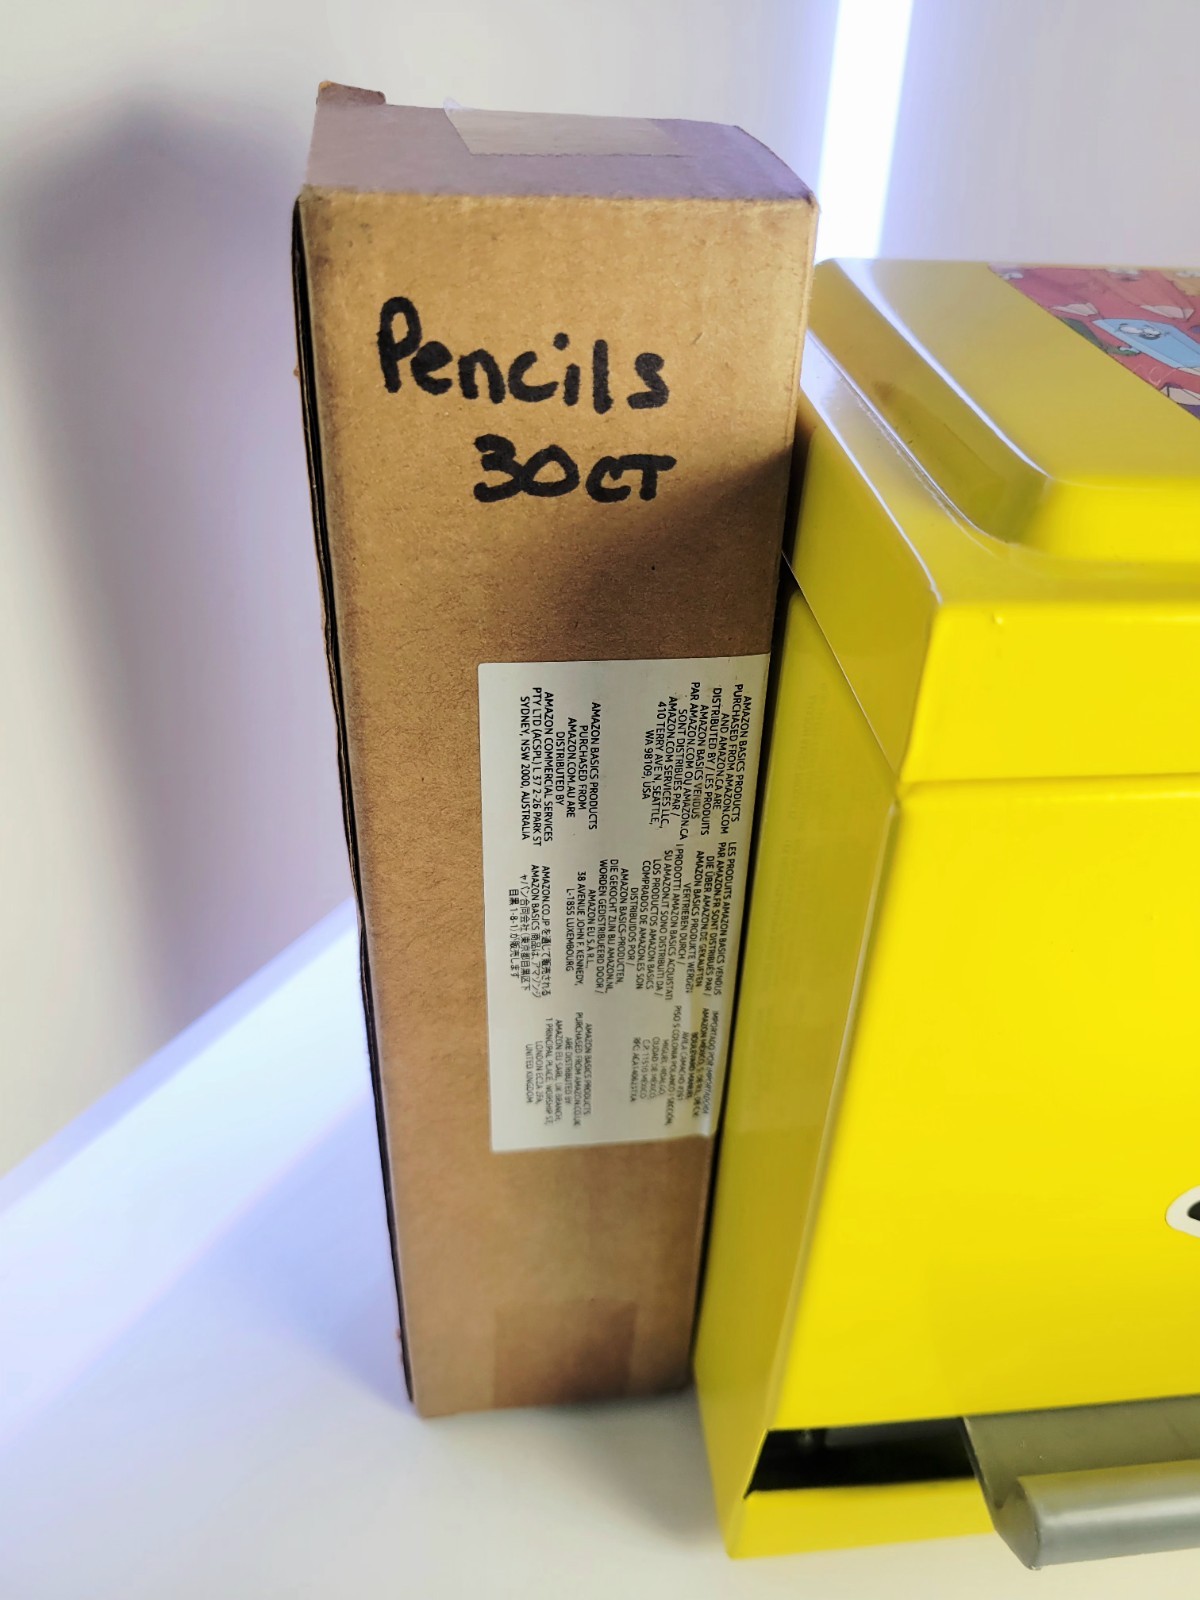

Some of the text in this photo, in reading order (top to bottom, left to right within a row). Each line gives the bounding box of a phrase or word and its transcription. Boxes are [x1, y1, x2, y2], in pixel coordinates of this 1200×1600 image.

[377, 296, 670, 414] Pencils
[533, 687, 541, 705] PTY
[533, 708, 541, 726] LTD
[665, 696, 677, 762] AMAZON.COM
[677, 709, 687, 734] SONT
[520, 696, 530, 839] SYDNEY, NSW 2000, AUSTRALIA
[533, 728, 541, 764] (ACSPL)
[544, 692, 553, 841] AMAZON COMMERCIAL SERVICES
[567, 717, 577, 817] AMAZON.COM.AU ARE
[578, 725, 588, 810] PURCHASED FROM
[589, 702, 601, 829] AMAZON BASICS PRODUCTS
[642, 730, 654, 799] WA 98109, USA
[649, 701, 666, 824] 410 TERRY AVE N, SEATTLE,
[680, 682, 700, 839] PAR AMAZON.COM OU AMAZON.CA
[691, 705, 709, 819] AMAZON BASICS VENDUS
[701, 688, 722, 835] DISTRIBUTED BY LES PRODUITS
[713, 713, 729, 809] AND AMAZON.CA ARE
[721, 684, 743, 833] PURCHASED FROM AMAZON.COM
[731, 696, 752, 822] AMAZON BASICS PRODUCTS
[533, 775, 541, 785] 37
[556, 732, 565, 805] DISTRIBUTED BY
[663, 764, 673, 806] SERVICES
[533, 788, 541, 809] 2-26
[672, 793, 682, 810] PAR
[533, 811, 541, 833] PARK
[533, 835, 541, 846] ST
[610, 859, 618, 872] DIE
[673, 848, 683, 891] PRODOTTI
[705, 856, 714, 869] DIE
[717, 842, 726, 858] PAR
[531, 864, 539, 900] AMAZON
[542, 866, 550, 926] AMAZON.CO.JP
[577, 871, 585, 881] 38
[609, 874, 618, 912] GEKOCHT
[704, 870, 715, 892] ÜBER
[712, 859, 724, 907] AMAZON.FR
[531, 902, 539, 930] BASICS
[577, 883, 585, 915] AVENUE
[656, 850, 673, 990] SU AMAZON.IT SONO DISTRIBUITI DA
[670, 893, 680, 927] AMAZON
[700, 894, 711, 941] AMAZON.DE
[710, 909, 720, 930] SONT
[714, 842, 736, 995] LES PRODUITS AMAZON BASICS VENDUS
[566, 888, 574, 971] L-1855 LUXEMBOURG
[596, 859, 607, 988] WORDEN GEDISTRIBUEERD DOOR
[607, 933, 616, 944] BIJ
[608, 915, 616, 931] ZIJN
[615, 868, 628, 984] AMAZON BASICS-PRODUCTEN,
[627, 888, 638, 960] DISTRIBUIDOS POR
[636, 860, 650, 989] COMPRADOS DE AMAZON.ES SON
[646, 859, 661, 989] LOS PRODUCTOS AMAZON BASICS
[668, 929, 677, 956] BASICS
[678, 883, 691, 959] VERTRIEBEN DURCH
[574, 949, 584, 985] KENNEDY,
[665, 958, 675, 1000] ACQUISTATI
[704, 977, 713, 990] PAR
[671, 1028, 680, 1059] COLONIA
